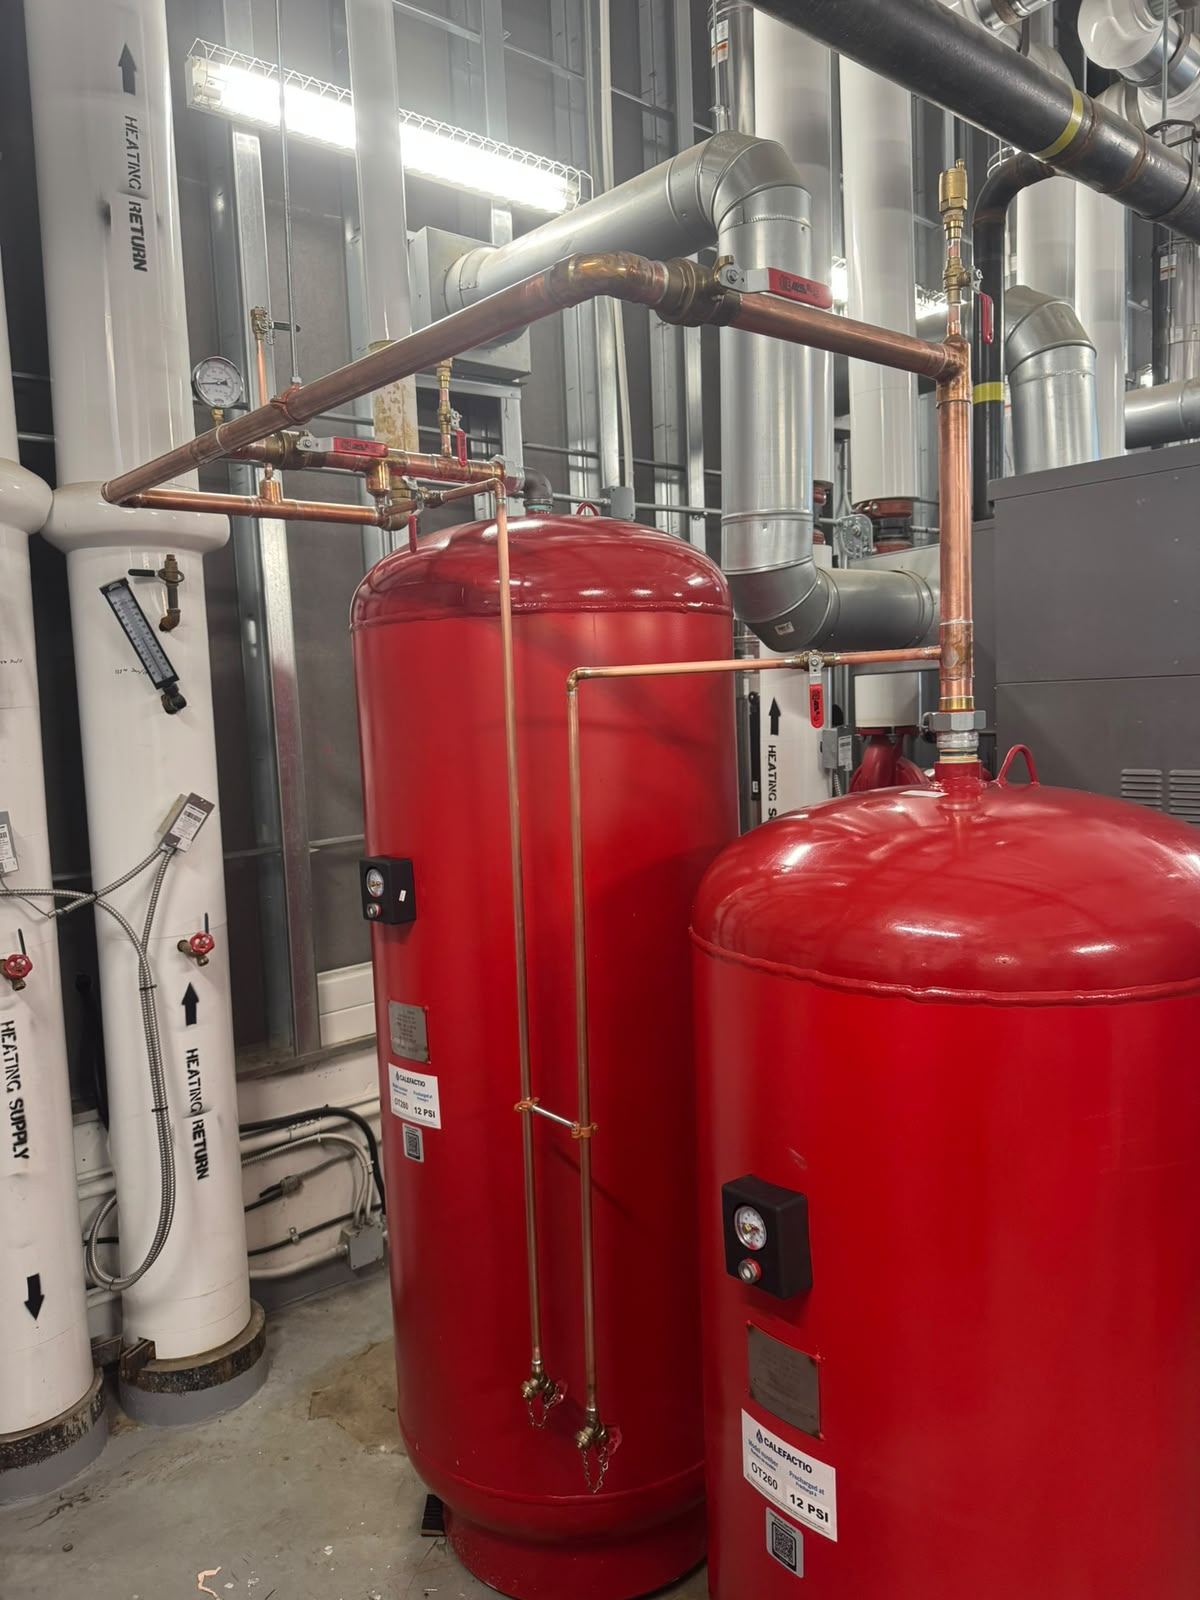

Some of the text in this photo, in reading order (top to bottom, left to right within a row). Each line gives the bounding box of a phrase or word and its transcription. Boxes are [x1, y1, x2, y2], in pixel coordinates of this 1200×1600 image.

[124, 115, 148, 272] HEATING RETURN
[768, 745, 778, 801] HEATING
[0, 1020, 30, 1160] HEATING SUPPLY
[399, 1074, 426, 1088] CALEFACTIO
[186, 1048, 209, 1180] HEATING RETURN
[414, 1106, 422, 1115] 12
[423, 1108, 436, 1118] PSI
[764, 1437, 813, 1474] CALEFACTIO
[751, 1462, 778, 1491] OT260
[788, 1470, 825, 1496] Precharged at
[789, 1494, 804, 1510] 12
[808, 1504, 829, 1523] PSI
